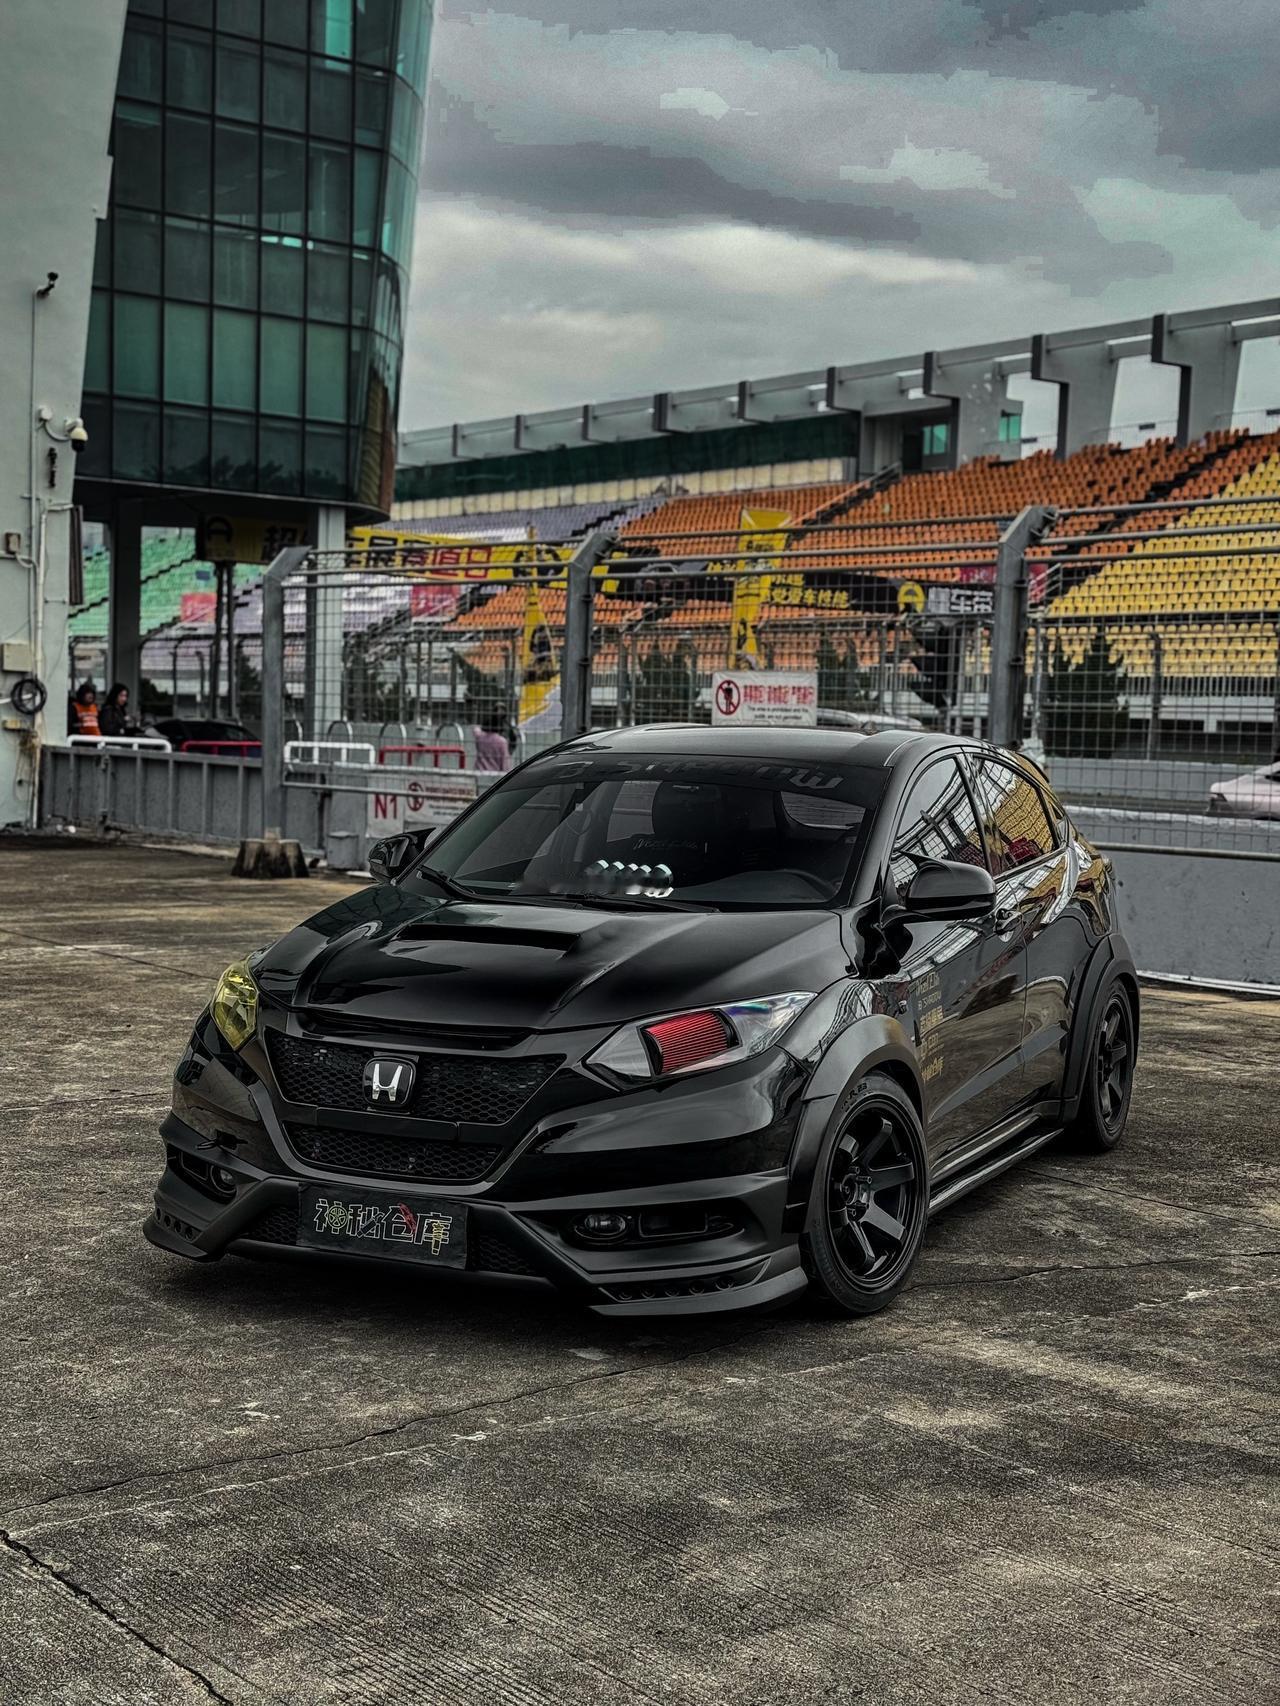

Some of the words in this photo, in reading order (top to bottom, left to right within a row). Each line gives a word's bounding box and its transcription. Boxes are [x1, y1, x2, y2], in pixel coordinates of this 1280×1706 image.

[374, 792, 398, 819] N1
[313, 1198, 453, 1256] 神秘仓库
